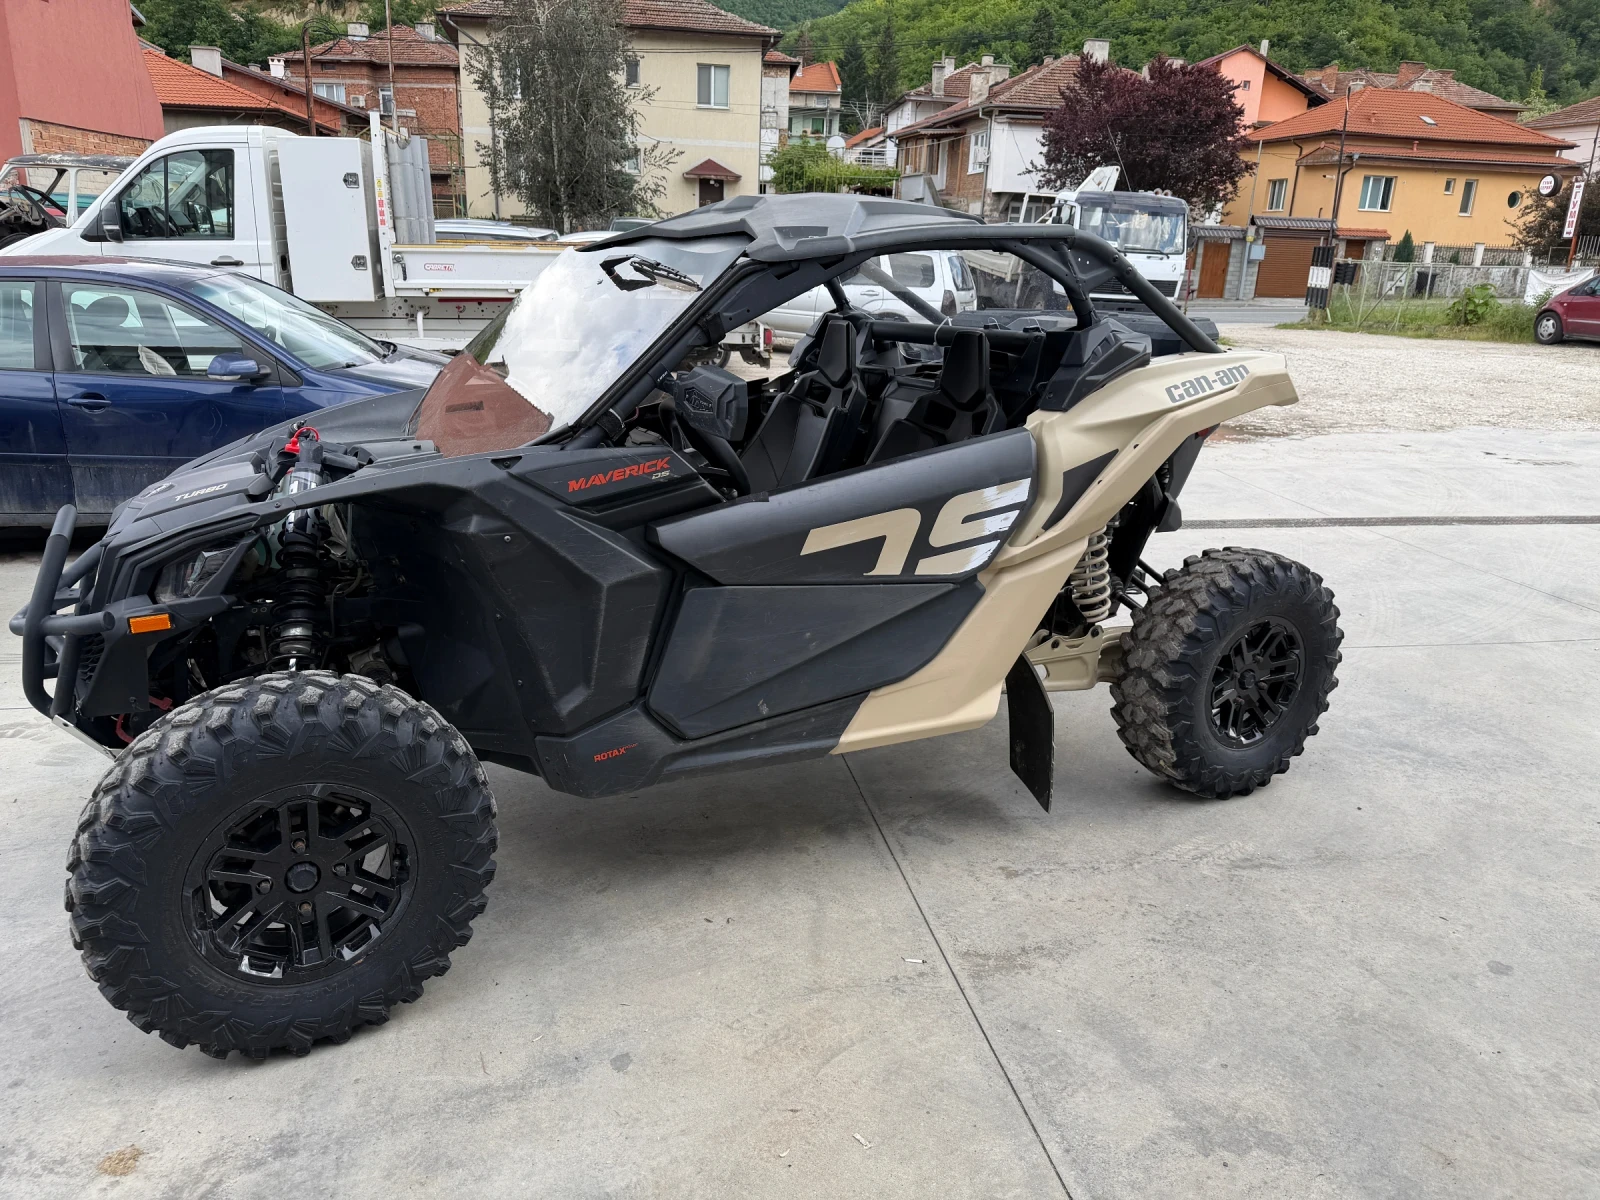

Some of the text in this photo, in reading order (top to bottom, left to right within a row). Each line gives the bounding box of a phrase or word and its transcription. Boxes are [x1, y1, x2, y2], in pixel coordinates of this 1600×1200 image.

[1165, 364, 1250, 403] can-am
[568, 457, 670, 492] MAVERICK
[652, 470, 670, 480] DS
[175, 483, 228, 501] TURBO
[594, 747, 626, 762] ROTAX
